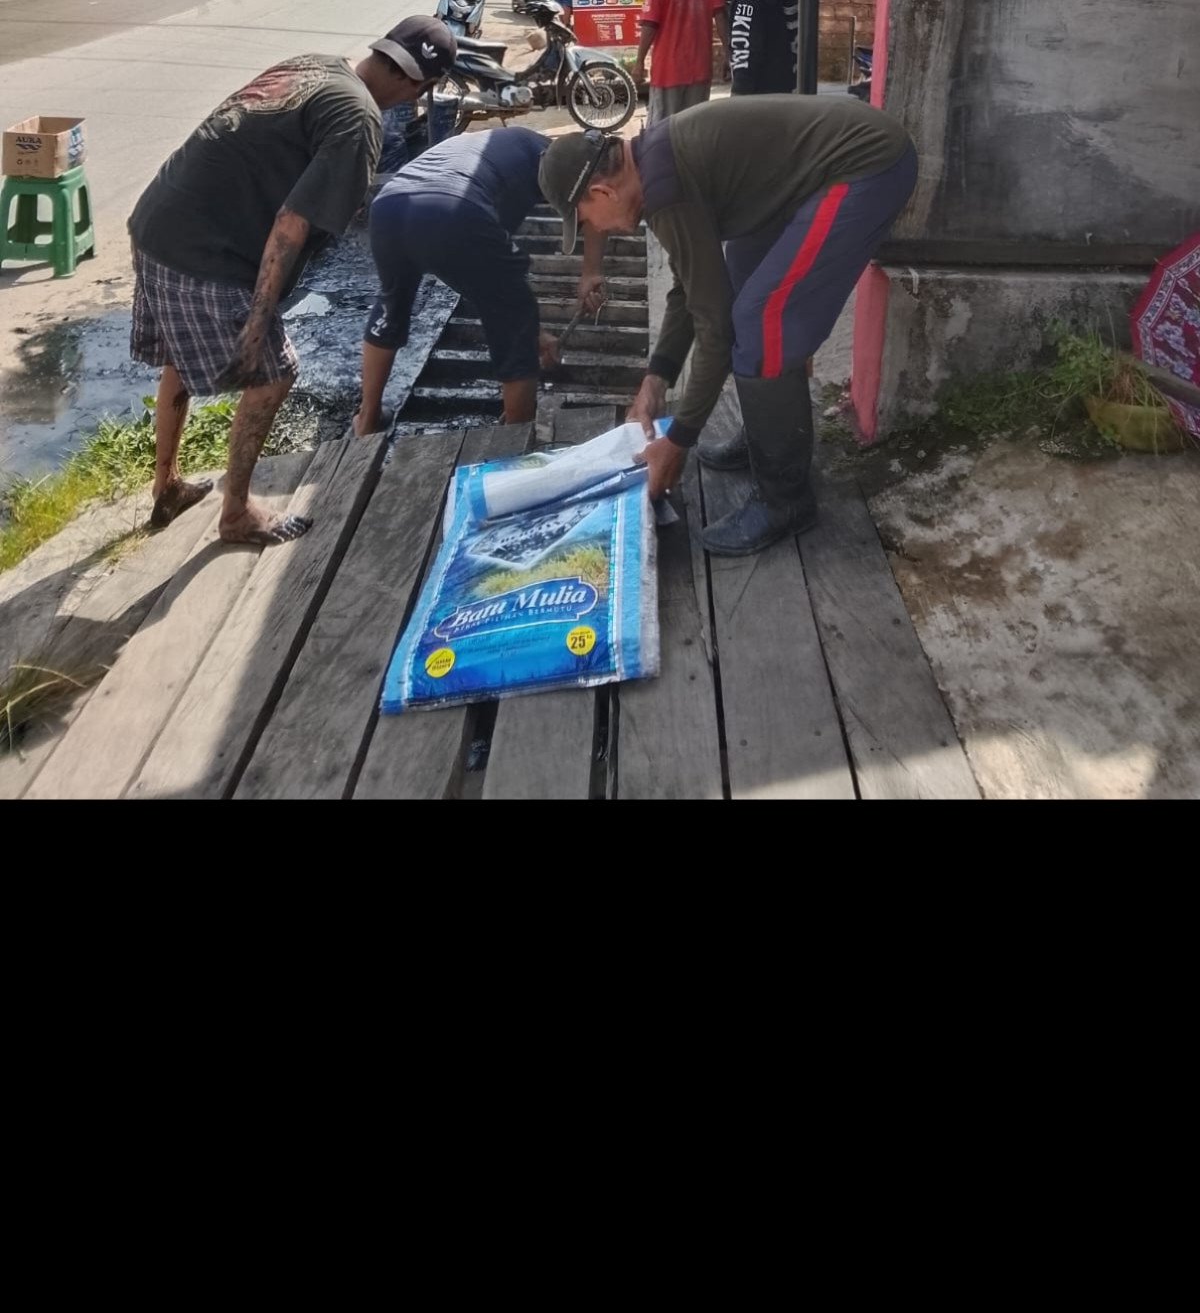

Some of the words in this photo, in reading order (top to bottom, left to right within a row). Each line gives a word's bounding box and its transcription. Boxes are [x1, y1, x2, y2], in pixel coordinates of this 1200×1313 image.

[735, 3, 754, 17] STD
[450, 601, 508, 627] Batu
[512, 585, 587, 612] Mulia
[528, 605, 572, 616] BERMUTU
[570, 635, 586, 649] 25
